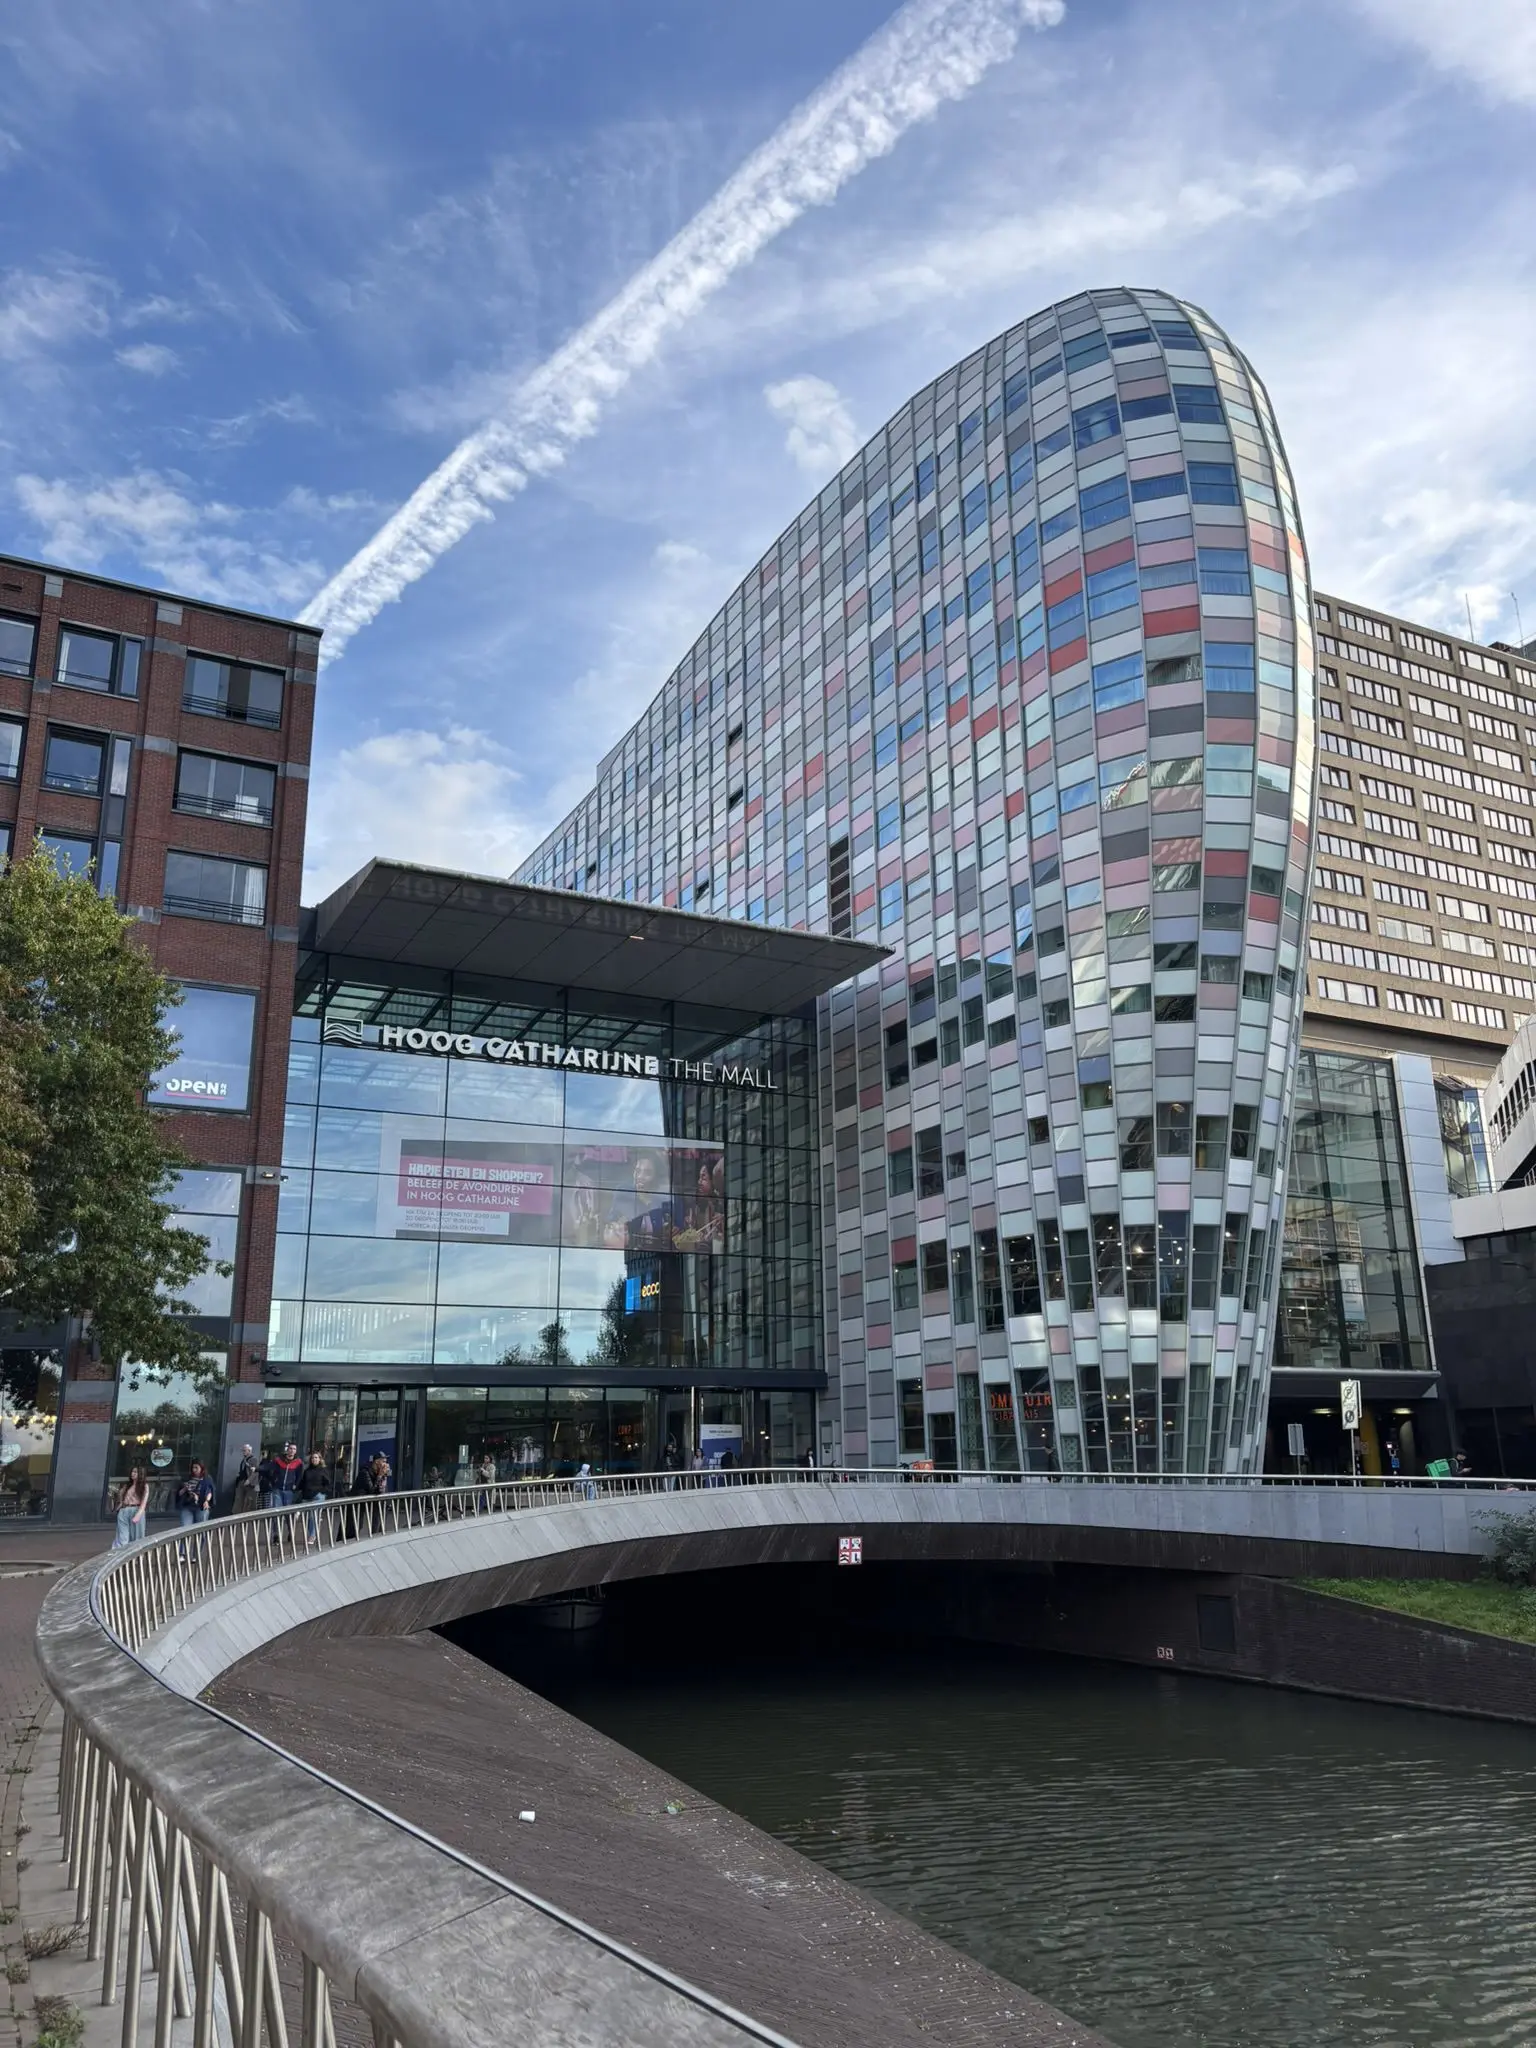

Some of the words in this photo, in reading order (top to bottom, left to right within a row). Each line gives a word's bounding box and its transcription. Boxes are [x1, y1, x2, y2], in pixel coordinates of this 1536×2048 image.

[382, 1025, 475, 1054] HOOG
[486, 1037, 659, 1075] CATHARIJNE
[669, 1058, 714, 1082] THE
[722, 1064, 778, 1089] MALL
[166, 1078, 219, 1095] OPEN
[444, 1165, 470, 1179] ETEN
[472, 1168, 486, 1180] EN
[488, 1169, 543, 1184] SHOPPEN?
[407, 1178, 442, 1190] BELEEF
[446, 1180, 459, 1191] DE
[462, 1181, 524, 1195] AVONDUREN
[406, 1190, 417, 1200] IN
[420, 1191, 455, 1202] HOOG
[457, 1193, 520, 1206] CATHARIJNE
